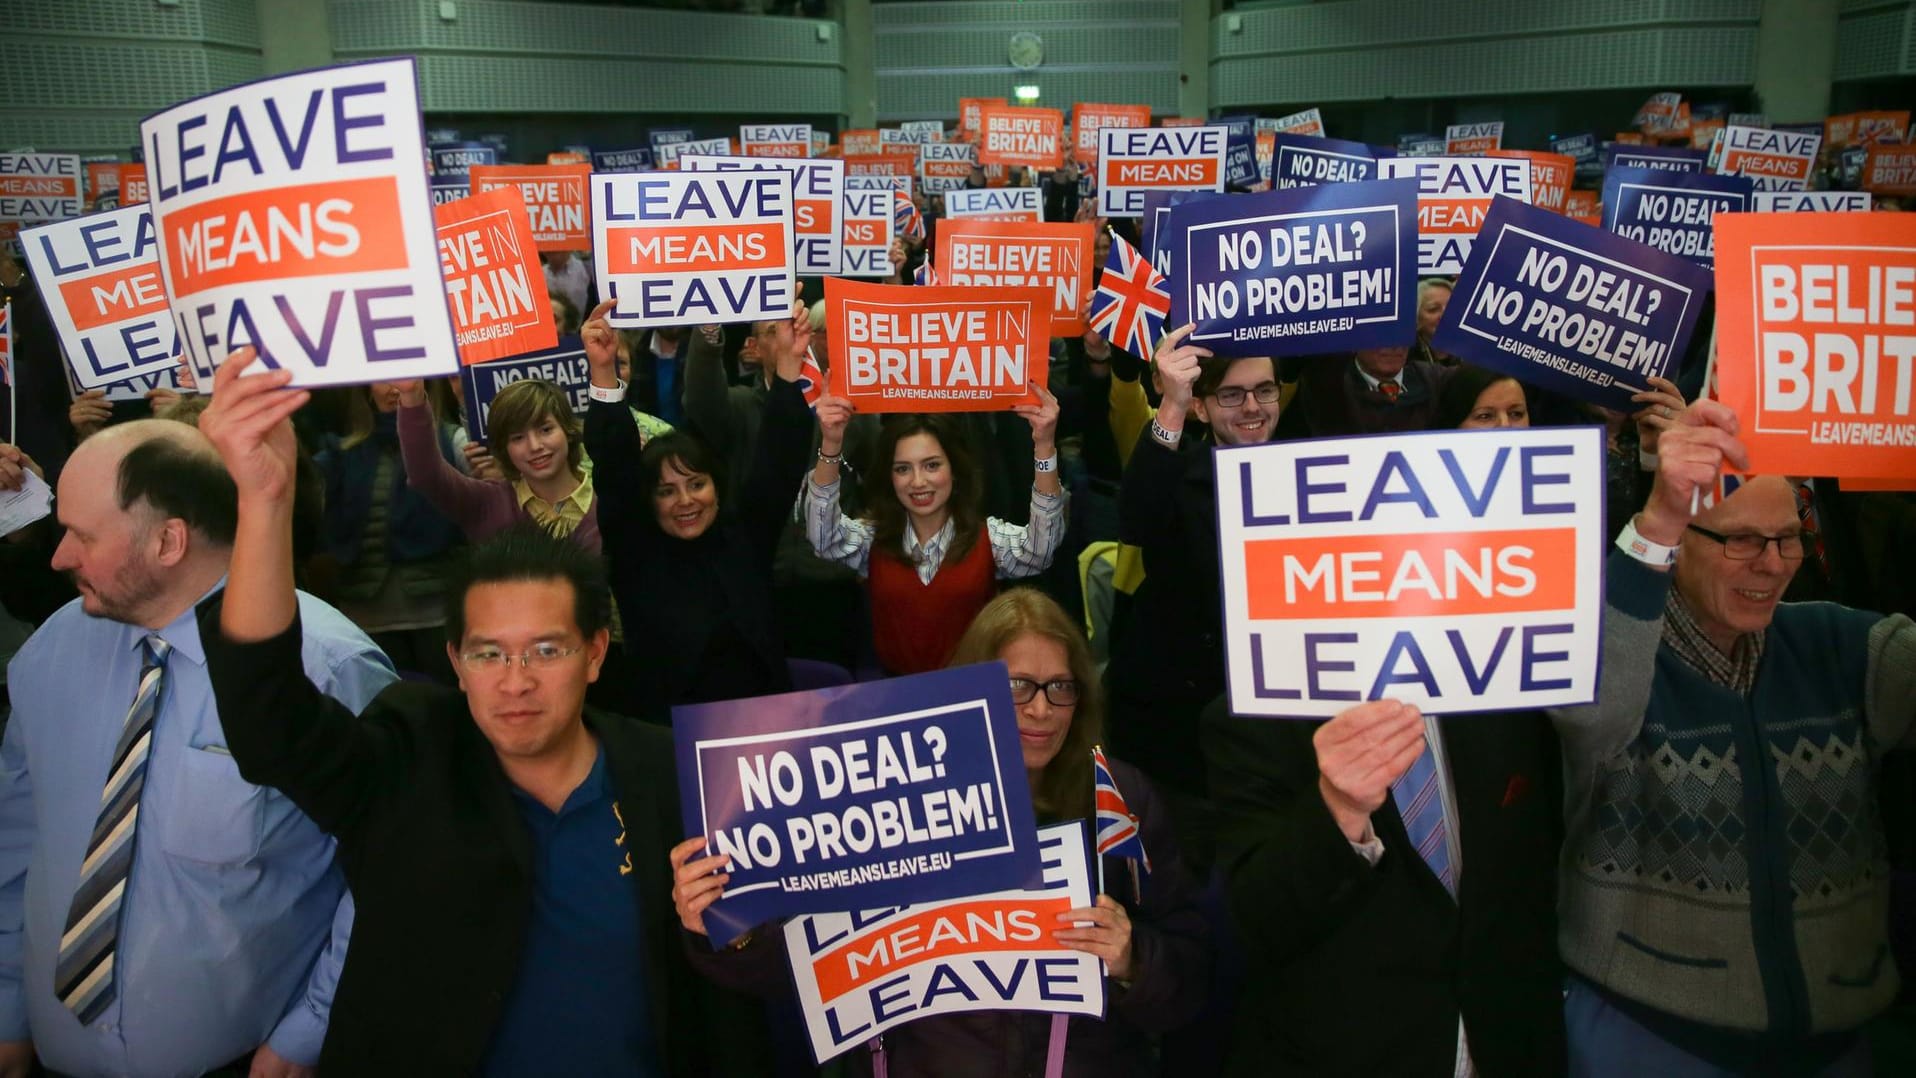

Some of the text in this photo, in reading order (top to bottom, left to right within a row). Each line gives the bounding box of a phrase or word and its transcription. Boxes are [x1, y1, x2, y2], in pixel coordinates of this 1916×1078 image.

[745, 127, 807, 141] LEAVE
[989, 117, 1041, 133] BELIEVE
[1044, 121, 1056, 134] IN
[1080, 115, 1128, 129] BELIEVE
[1276, 111, 1316, 130] LEAVE
[1450, 124, 1498, 138] LEAVE
[153, 81, 394, 201] LEAVE
[664, 141, 725, 160] LEAVE
[752, 145, 800, 156] MEANS
[881, 131, 929, 144] LEAVE
[988, 133, 1055, 153] BRITAIN
[1107, 131, 1219, 156] LEAVE
[1730, 129, 1815, 156] LEAVE
[0, 157, 74, 174] EAVE
[441, 150, 485, 166] NO DEAL?
[603, 152, 642, 166] NO DEAL?
[850, 164, 894, 175] BELIEVE
[1291, 154, 1313, 176] NO
[1315, 157, 1367, 182] DEAL?
[1736, 154, 1799, 175] MEANS
[925, 179, 968, 191] LEAV
[1120, 164, 1204, 182] MEANS
[1753, 177, 1803, 192] AVE
[1873, 168, 1916, 184] BRITA
[1, 199, 79, 216] EAVE
[604, 179, 783, 221] LEAVE
[952, 191, 1037, 213] LEAVE
[1533, 186, 1564, 208] TAIN
[1637, 194, 1668, 222] NO
[527, 204, 582, 231] TAIN
[1418, 206, 1491, 228] MEAN
[40, 212, 157, 276] LEA
[178, 198, 361, 279] MEANS
[488, 222, 518, 262] IN
[630, 233, 767, 264] MEANS
[1218, 230, 1263, 272] NO
[1270, 221, 1366, 267] DEAL?
[1648, 227, 1714, 257] PROBLE
[953, 243, 1078, 272] BELIEVE IN
[1157, 249, 1171, 275] N
[448, 264, 533, 327] TAIN
[608, 274, 788, 319] LEAVE
[1196, 267, 1391, 321] NO PROBLEM!
[1516, 246, 1568, 292] NO
[1566, 263, 1662, 326] DEAL?
[1761, 264, 1916, 326] BELIE
[180, 285, 426, 378] LEAVE
[457, 322, 514, 346] EANSLEAVE.EU
[848, 309, 1026, 344] BELIEVE IN
[1233, 316, 1353, 341] LEAVEMEANSLEAVE.EU
[1475, 281, 1666, 377] NO PROBLEM!
[849, 344, 1025, 386] BRITAIN
[1497, 336, 1614, 387] LEAVEMEANSLEAVE.EU
[1763, 331, 1916, 416] BRIT
[882, 388, 992, 399] LEAVEMEANSLEAVE.EU
[1810, 421, 1916, 447] LEAVEMEANS
[1240, 444, 1576, 527] LEAVE
[1283, 545, 1537, 604] MEANS
[1249, 623, 1575, 702] LEAVE
[737, 725, 948, 812] NO DEAL?
[714, 822, 782, 874] NO
[786, 782, 999, 864] PROBLEM!
[780, 851, 952, 893] LEAVEMEANSLEAVE.EU
[847, 909, 1041, 981] MEANS
[825, 958, 1084, 1047] LEAVE
